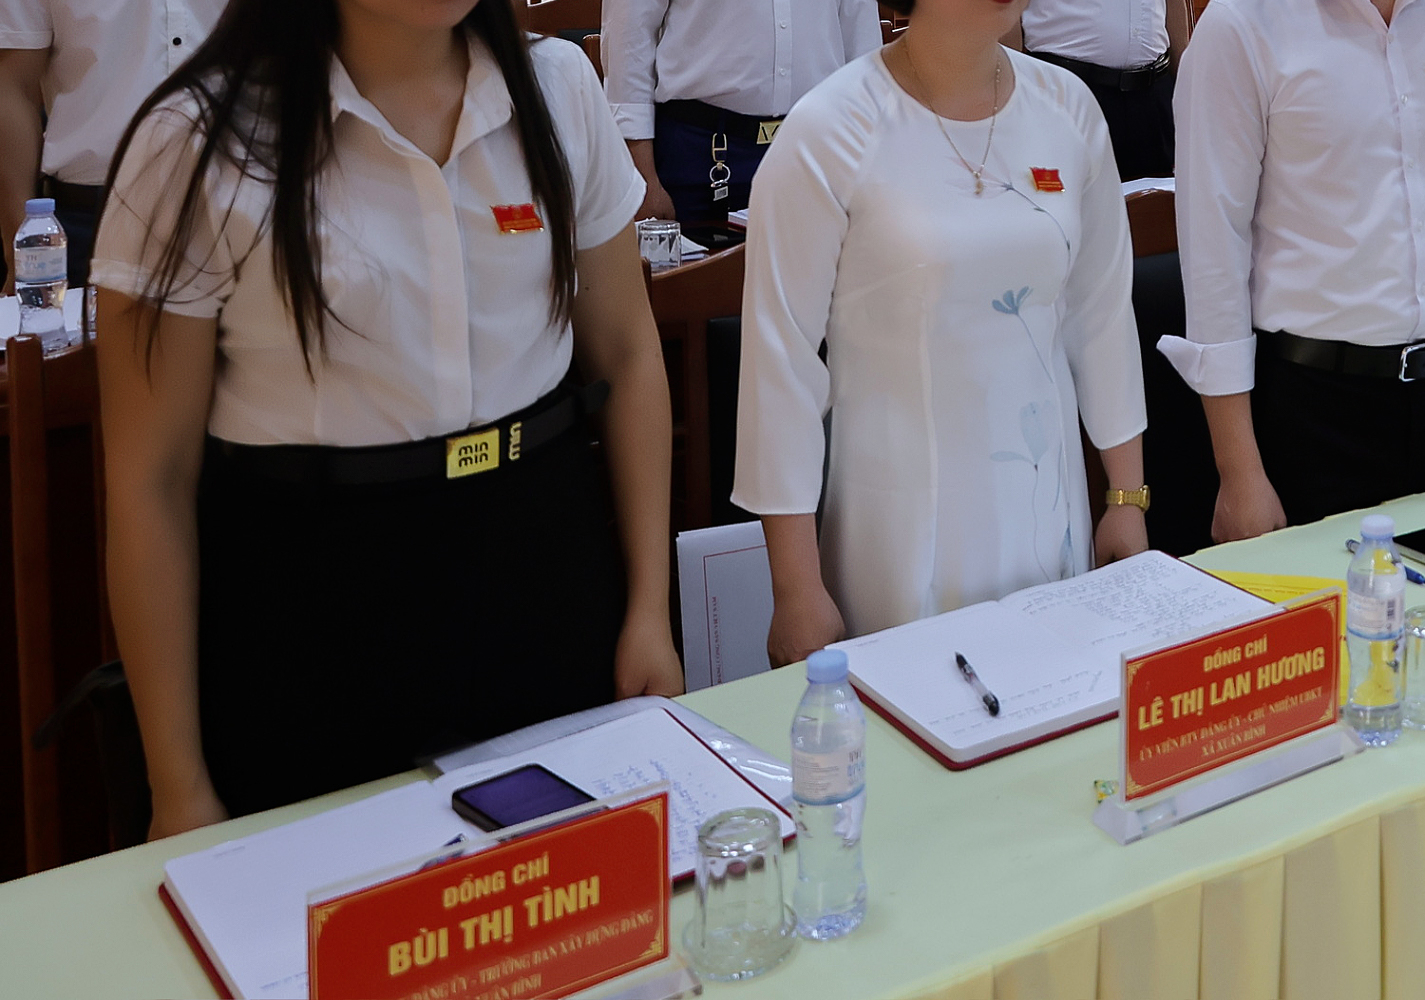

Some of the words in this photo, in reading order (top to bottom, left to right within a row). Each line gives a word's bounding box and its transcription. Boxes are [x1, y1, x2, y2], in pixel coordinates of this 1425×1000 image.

[458, 441, 489, 457] min
[459, 452, 489, 468] min
[1203, 646, 1241, 673] ĐỒNG
[1245, 634, 1268, 659] CHÍ
[1138, 696, 1164, 731] LÊ
[1170, 686, 1204, 719] THỊ
[1210, 670, 1251, 706] LAN
[1257, 646, 1325, 691] HƯƠNG
[442, 869, 506, 909] ĐỒNG
[512, 852, 549, 885] CHÍ
[388, 927, 449, 976] BÙI
[460, 905, 514, 949] THỊ
[523, 875, 601, 928] TÌNH
